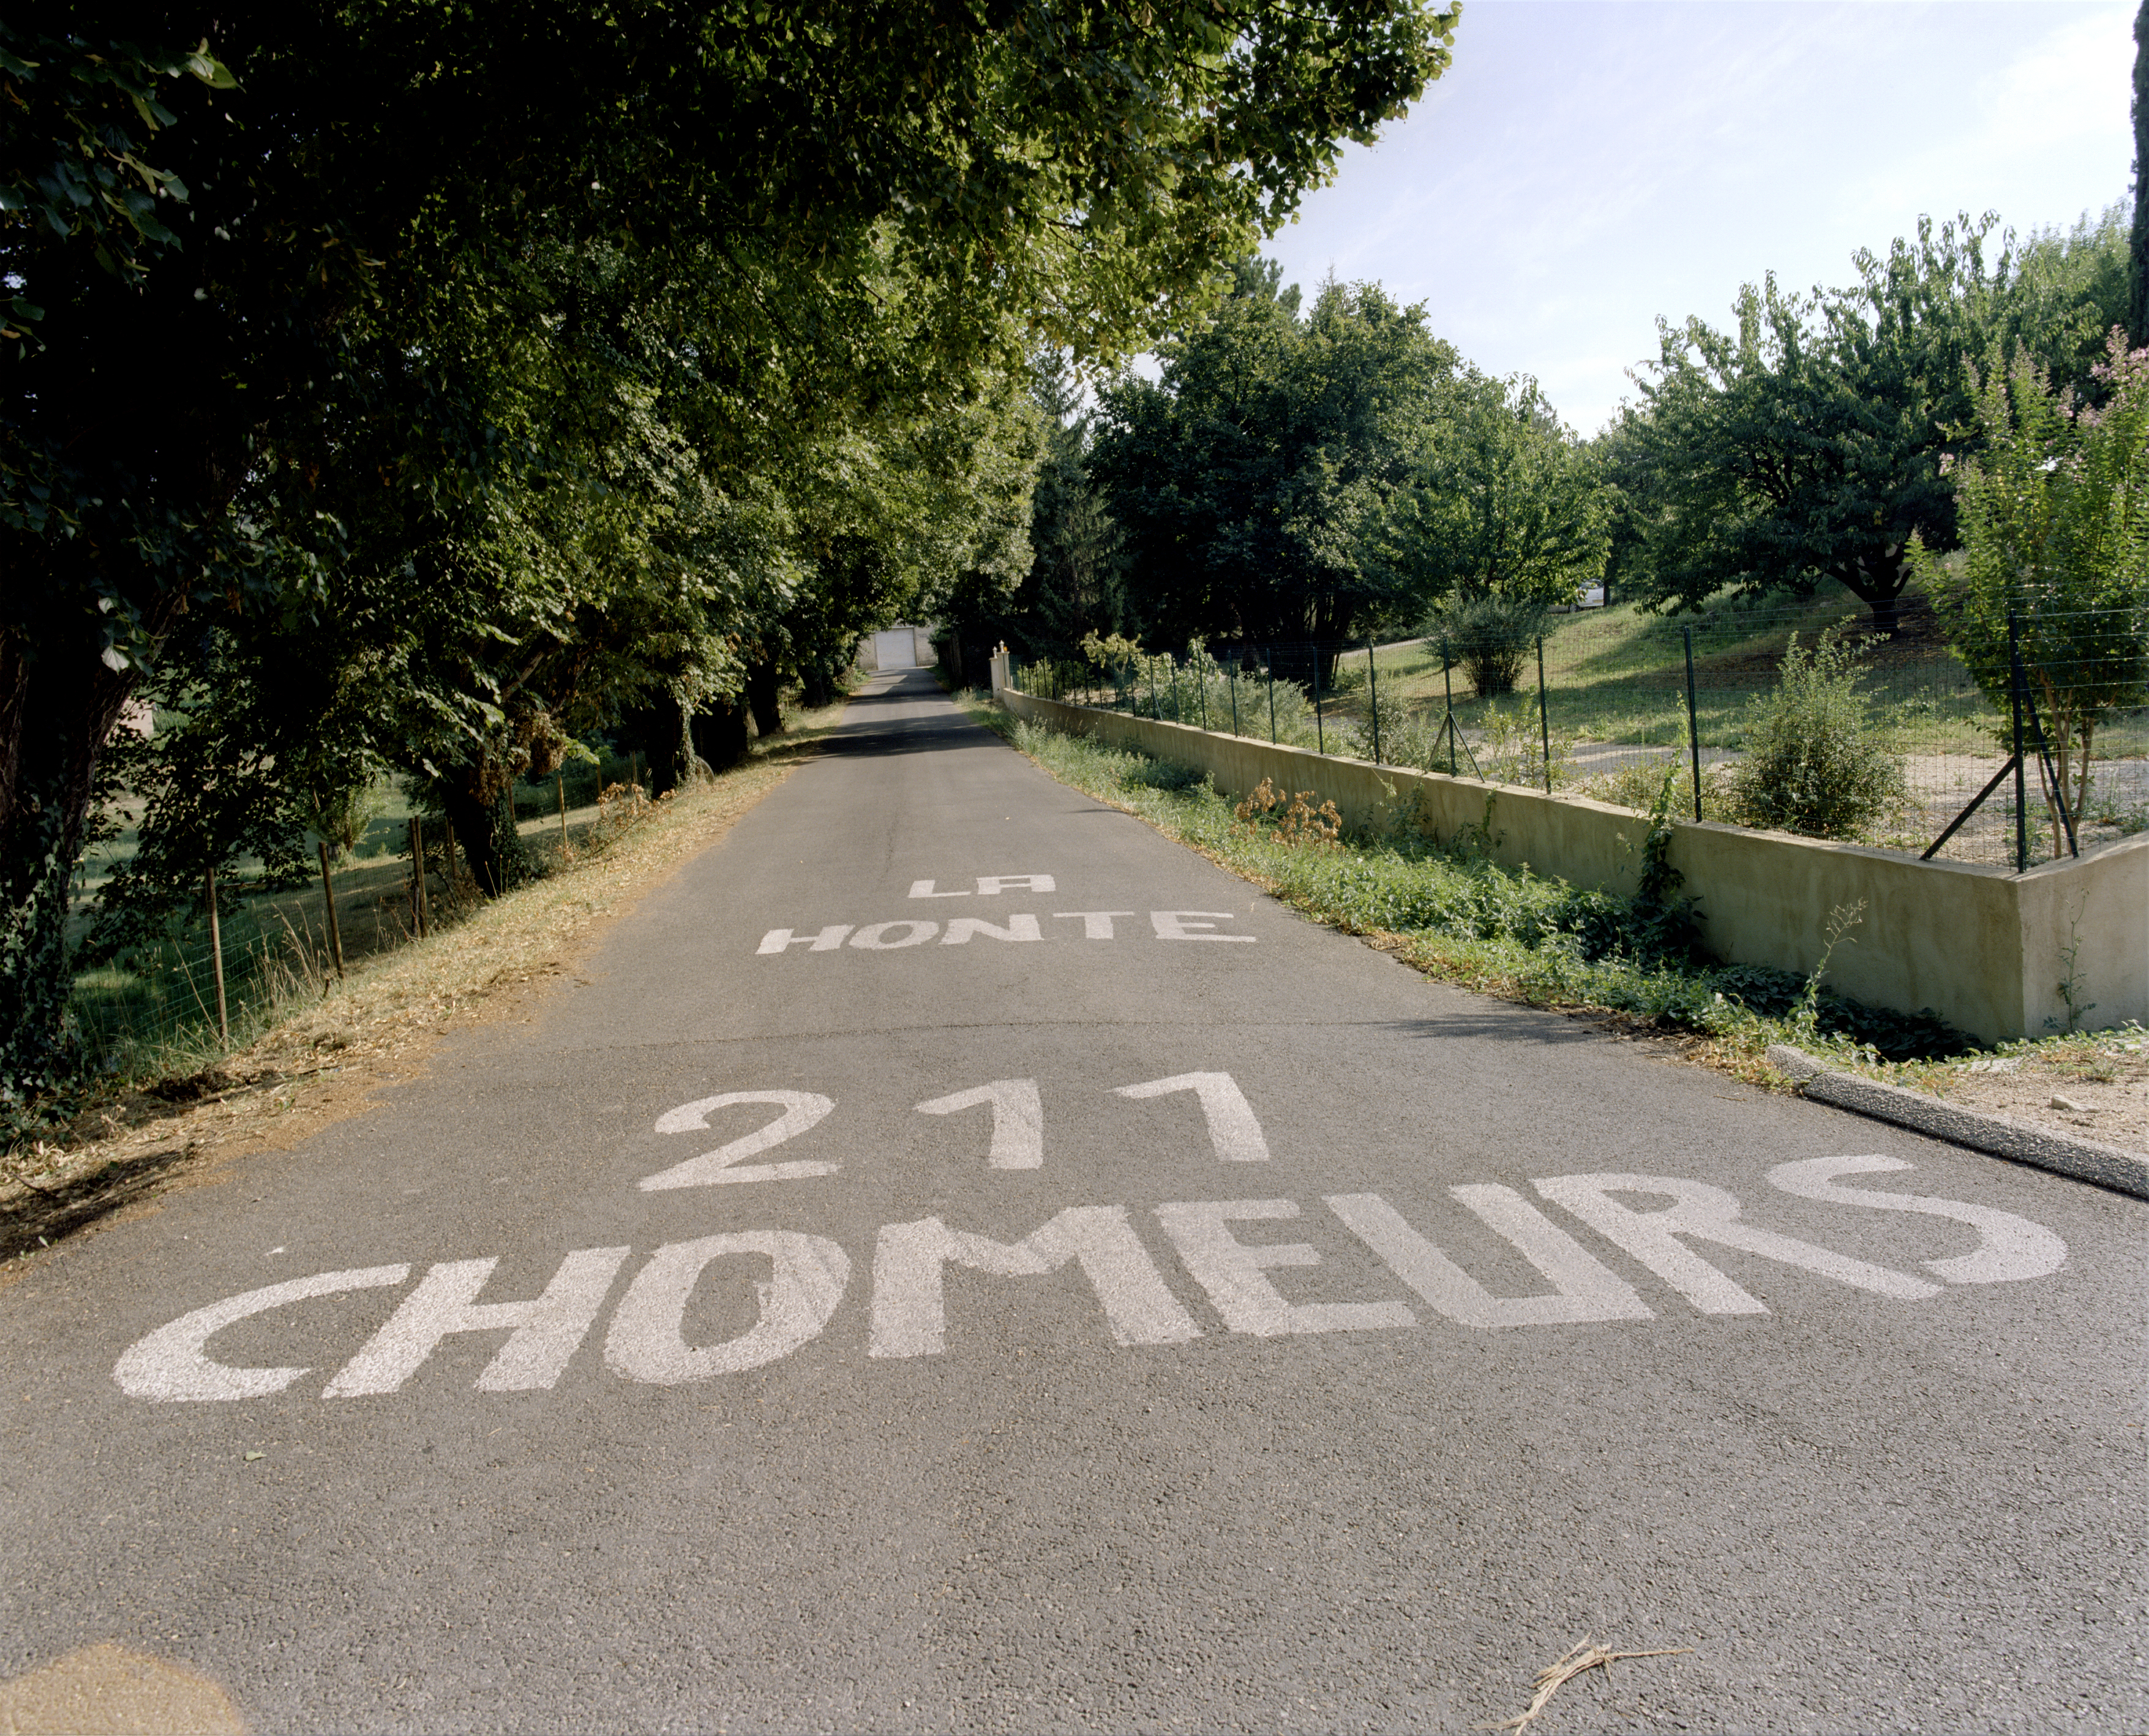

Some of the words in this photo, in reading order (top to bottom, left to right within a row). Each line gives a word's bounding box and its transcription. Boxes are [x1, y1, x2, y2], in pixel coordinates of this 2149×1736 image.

[909, 874, 1057, 899] LA
[757, 910, 1258, 955] HONTE
[639, 1070, 1270, 1192] 211
[112, 1154, 2069, 1403] CHOMEURS
